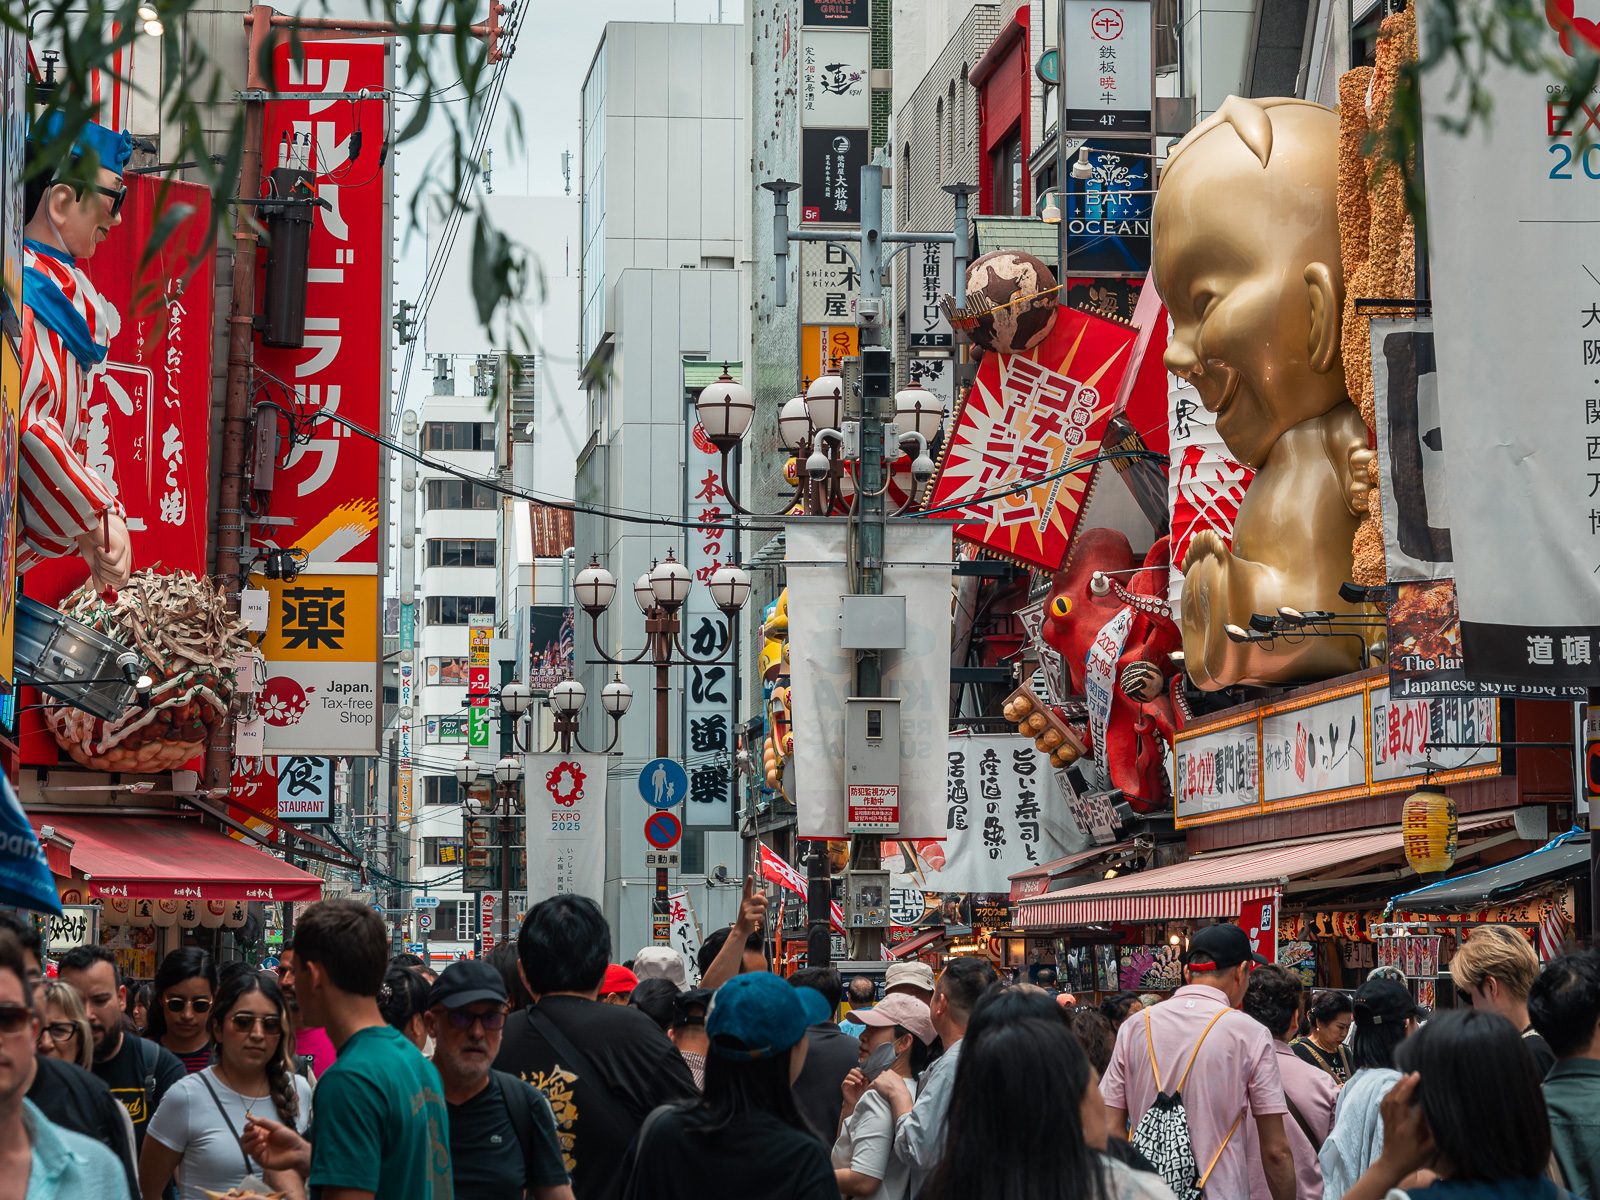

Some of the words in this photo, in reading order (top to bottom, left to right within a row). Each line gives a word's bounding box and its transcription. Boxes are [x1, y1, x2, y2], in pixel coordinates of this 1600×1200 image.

[820, 5, 852, 14] GRILL
[1043, 58, 1055, 74] 4
[1099, 45, 1117, 105] 鉄板暁牛
[1099, 116, 1116, 126] 4F
[1066, 138, 1080, 148] 3F
[1086, 189, 1133, 206] BAR
[805, 209, 817, 218] 5F
[1068, 219, 1149, 235] OCEAN
[923, 242, 942, 333] 浪花囲碁サロン
[133, 385, 144, 412] はち
[1064, 386, 1100, 446] 道頓堀
[133, 436, 144, 462] ばん
[952, 355, 1044, 525] ミュージアム
[160, 423, 187, 527] たこ焼
[695, 469, 725, 587] 本場の味
[281, 586, 346, 650] 薬
[1096, 631, 1119, 660] 2025
[1526, 635, 1592, 666] 道頓
[1401, 655, 1435, 672] The
[326, 681, 373, 695] Japan.
[402, 679, 411, 705] KORI
[471, 682, 489, 690] アコム
[1088, 678, 1110, 705] 関西
[1401, 679, 1476, 696] Japanese
[321, 697, 373, 709] Tax-free
[690, 616, 728, 803] かに道楽
[340, 711, 373, 726] Shop
[474, 708, 486, 742] レイク
[402, 725, 411, 758] RELAX
[1264, 739, 1293, 775] 新世界
[1186, 740, 1246, 802] 串カツ専門店
[850, 787, 896, 797] 防犯監視カメラ
[863, 797, 884, 805] 作動中
[947, 752, 969, 830] 居酒屋
[278, 801, 325, 812] STAURANT
[552, 813, 581, 822] EXPO
[979, 749, 1006, 860] 産直の魚の
[1012, 749, 1041, 867] 旨い寿司と、
[1408, 801, 1429, 828] KOBE
[552, 822, 581, 831] 2025
[646, 854, 679, 864] 自動車
[1408, 834, 1431, 859] BEEF
[975, 908, 1008, 917] フクロウの森
